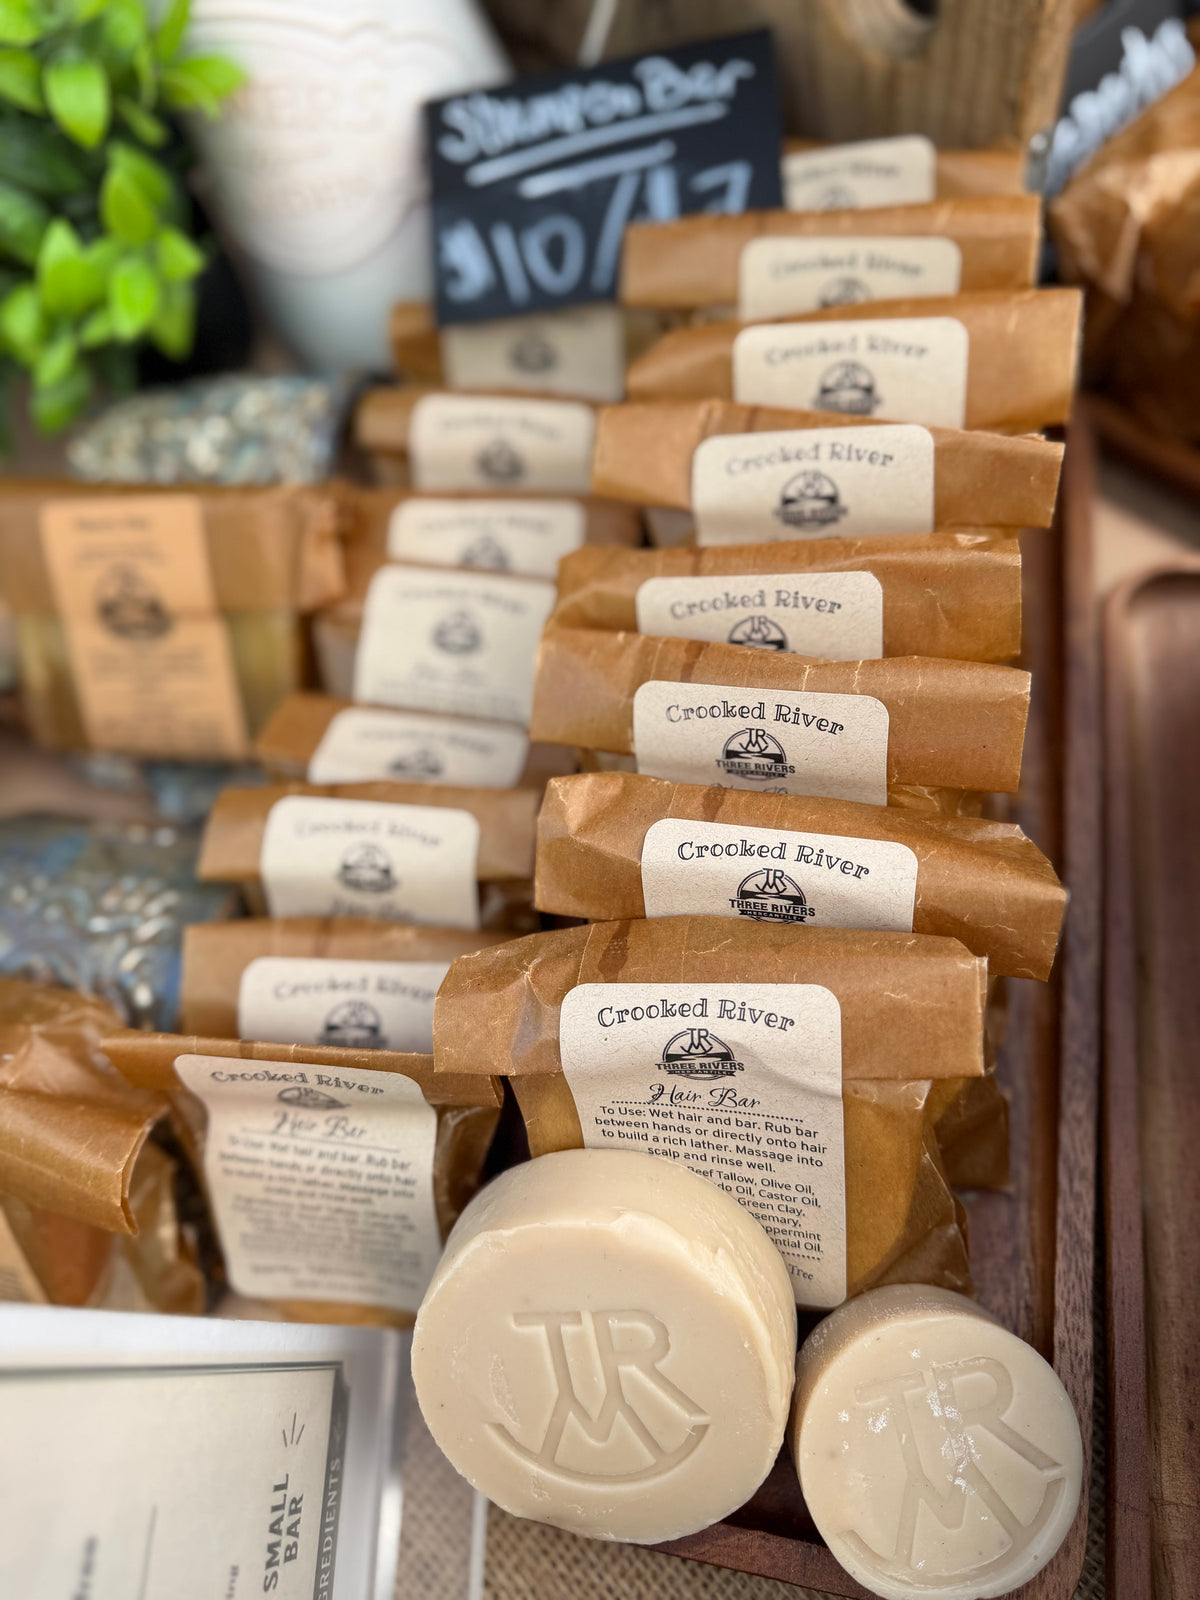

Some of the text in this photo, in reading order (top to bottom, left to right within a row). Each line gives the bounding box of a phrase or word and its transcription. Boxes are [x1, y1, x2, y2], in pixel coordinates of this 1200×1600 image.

[828, 443, 894, 467] River
[670, 590, 842, 619] Crooked River
[665, 701, 844, 736] Crooked River
[755, 763, 796, 774] RIVERS
[677, 840, 870, 879] Crooked River
[729, 899, 816, 917] THREE RIVERS
[597, 998, 796, 1032] Crooked River
[655, 1062, 745, 1072] THREE RIVERS
[211, 1070, 385, 1095] Crooked River
[646, 1083, 760, 1109] Hair Bar
[600, 1106, 819, 1138] To Use: Wet hair and bar. Rub bar
[594, 1117, 828, 1154] between hands or directly onto hair
[601, 1129, 824, 1167] to build a rich lather. Massage into
[647, 1147, 776, 1173] scalp and rinse well.
[758, 1189, 798, 1203] Castor
[760, 1178, 792, 1191] Olive
[737, 1197, 774, 1210] Green
[762, 1224, 822, 1241] ppermint
[263, 1473, 289, 1592] SMALL
[283, 1493, 304, 1563] BAR
